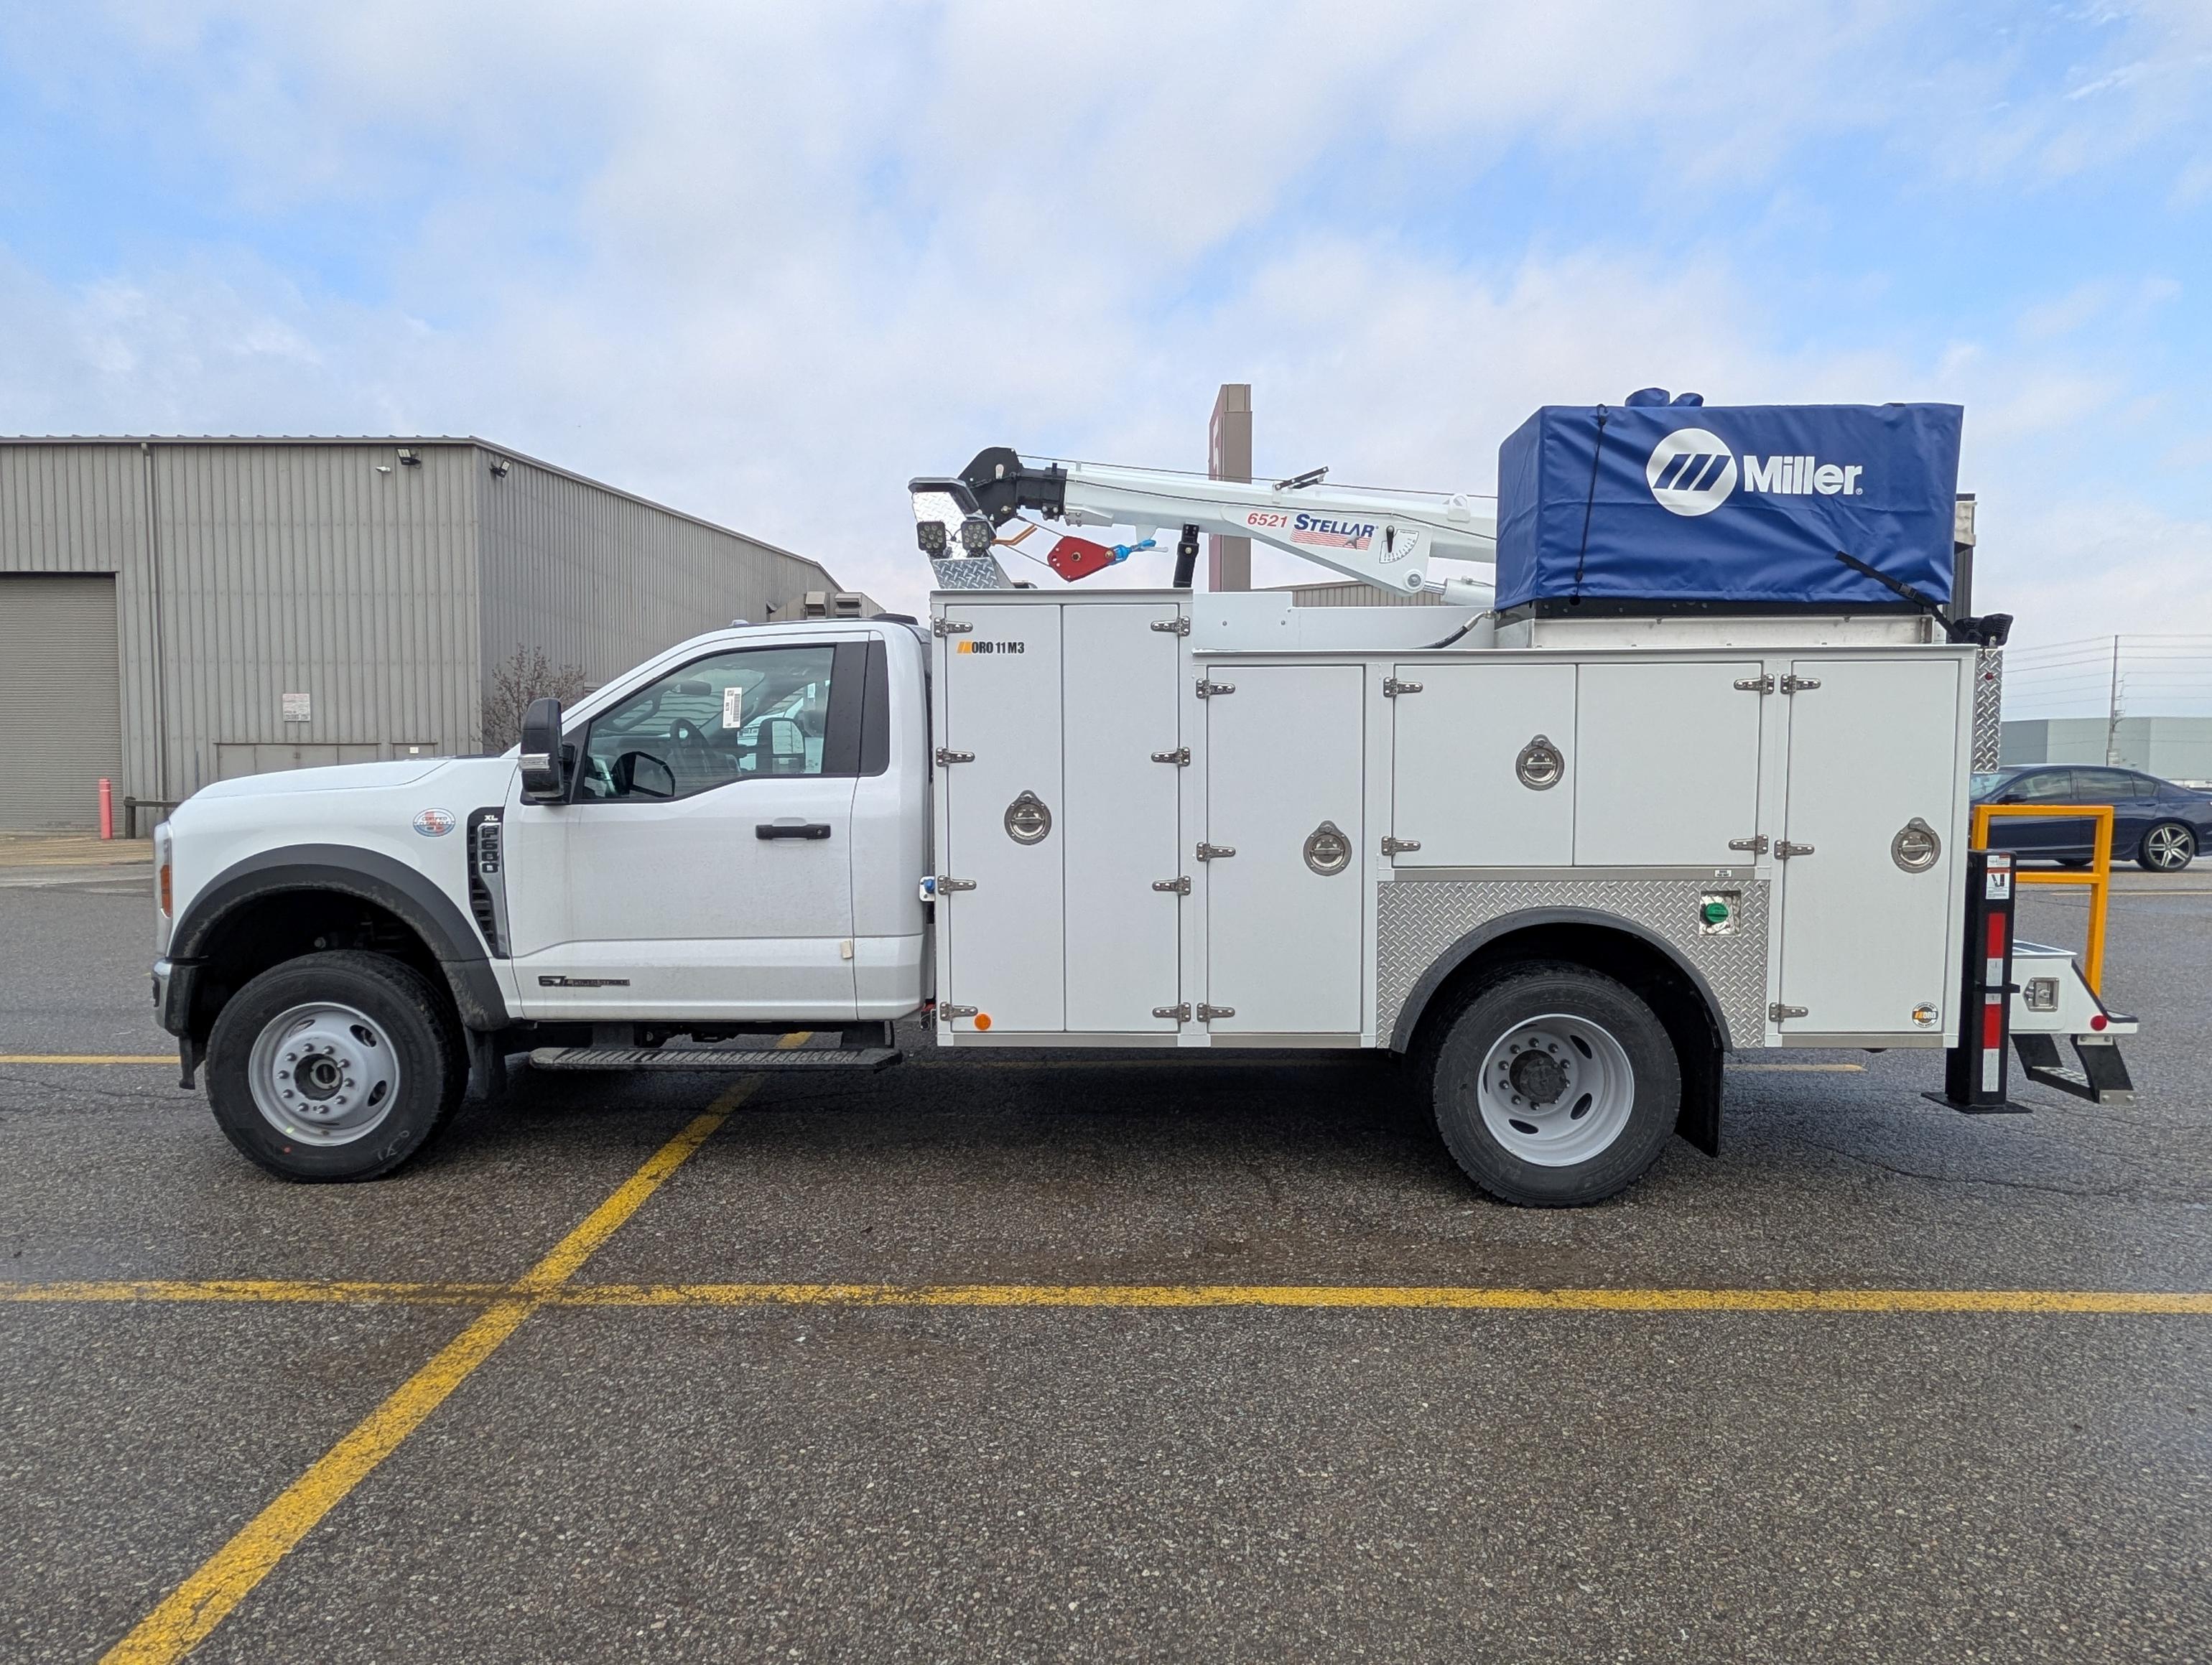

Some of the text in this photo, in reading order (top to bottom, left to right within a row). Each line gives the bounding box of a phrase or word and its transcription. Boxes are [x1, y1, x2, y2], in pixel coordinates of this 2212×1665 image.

[1743, 454, 1862, 495] Miller
[1247, 512, 1375, 538] 6521 STELLAR
[971, 641, 1025, 654] ORO 11 M3
[481, 825, 499, 874] F600
